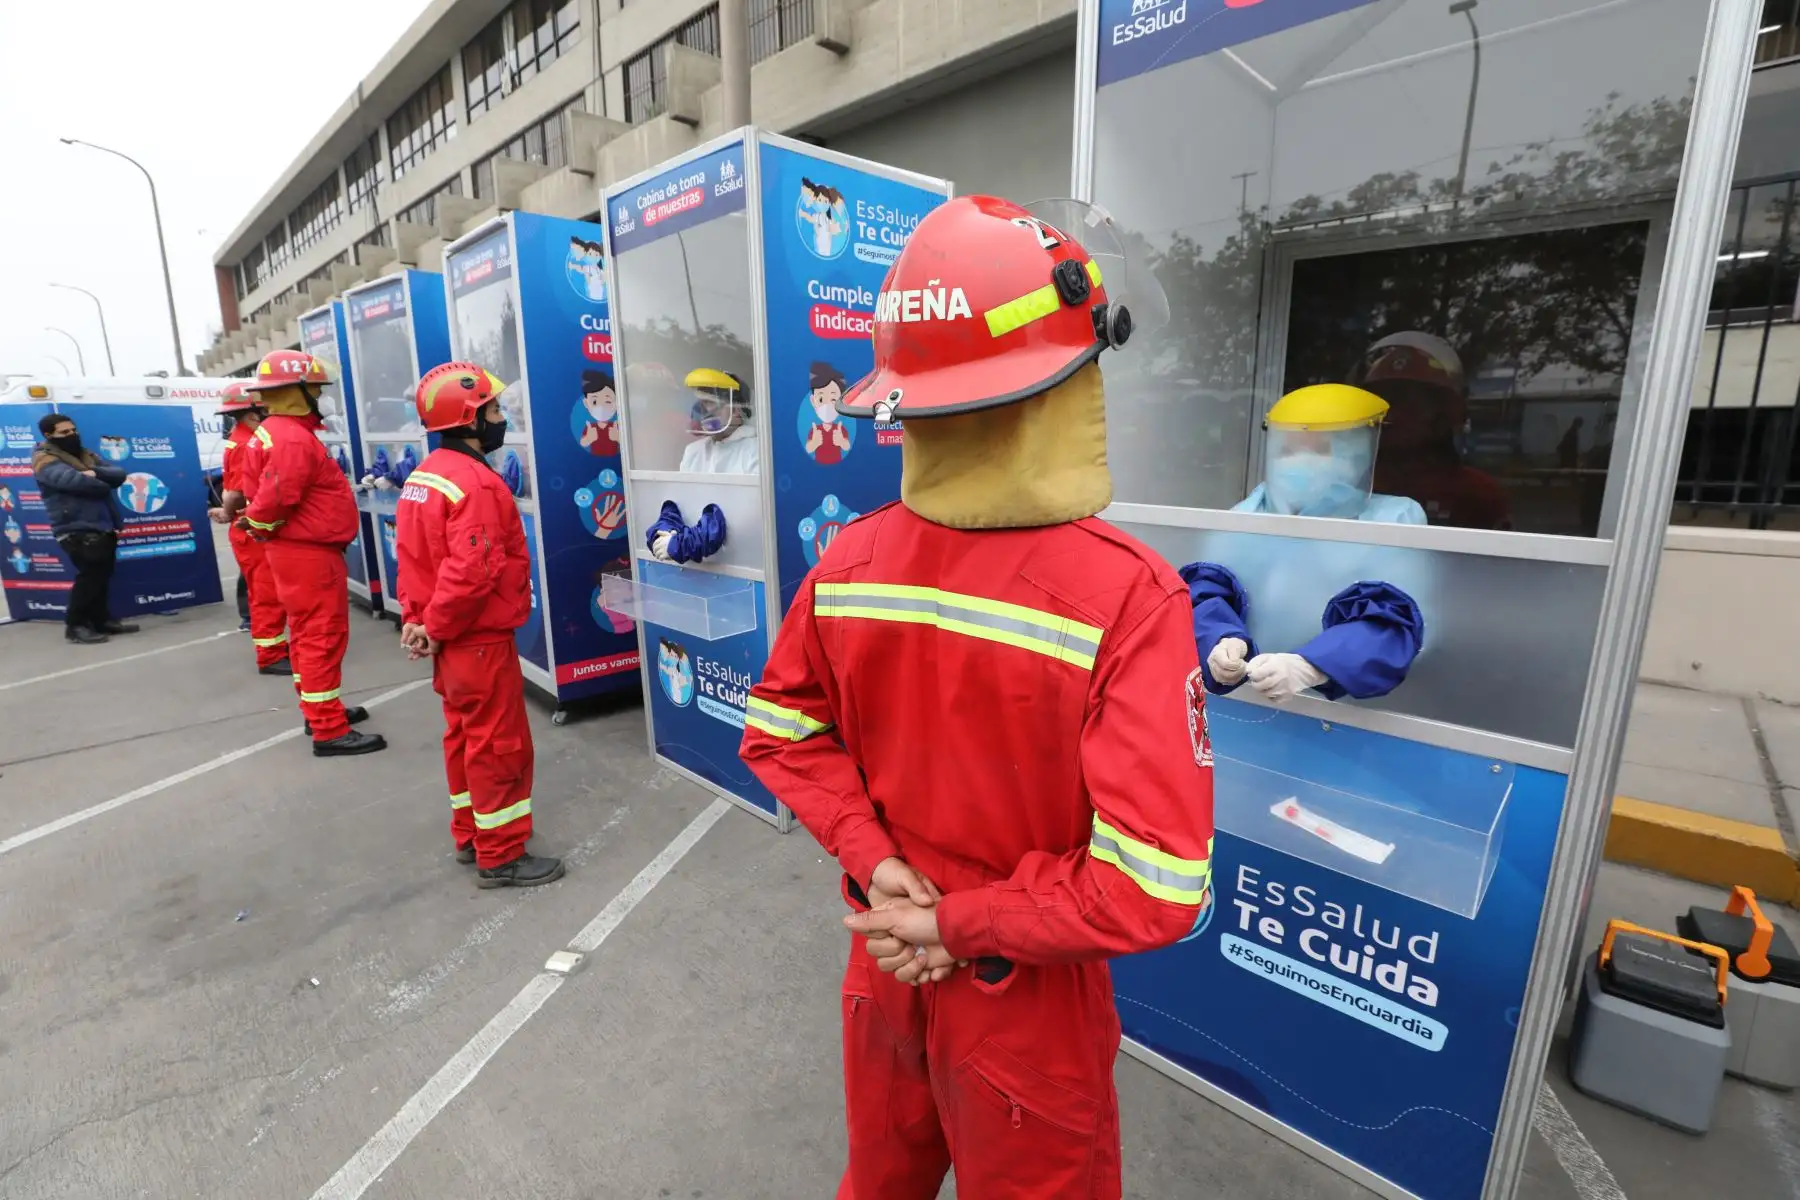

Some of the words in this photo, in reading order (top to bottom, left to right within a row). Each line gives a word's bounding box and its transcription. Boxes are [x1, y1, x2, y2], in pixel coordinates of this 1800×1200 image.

[1113, 0, 1186, 46] EsSalud
[637, 187, 664, 209] Cabina
[666, 182, 678, 197] de
[680, 171, 705, 191] toma
[714, 174, 743, 197] EsSalud
[645, 207, 657, 222] de
[658, 191, 700, 217] muestras
[856, 200, 918, 230] EsSalud
[856, 221, 876, 240] Te
[807, 279, 873, 309] Cumple
[814, 307, 873, 333] indicac
[877, 433, 884, 444] la
[573, 662, 608, 679] Juntos
[696, 655, 751, 690] EsSalud
[697, 675, 714, 696] Te
[716, 683, 748, 709] Cuid
[1236, 864, 1440, 965] EsSalud
[1233, 899, 1286, 945] Te
[1299, 926, 1440, 1008] Cuida
[1228, 941, 1434, 1042] #SeguimosEnGuardia
